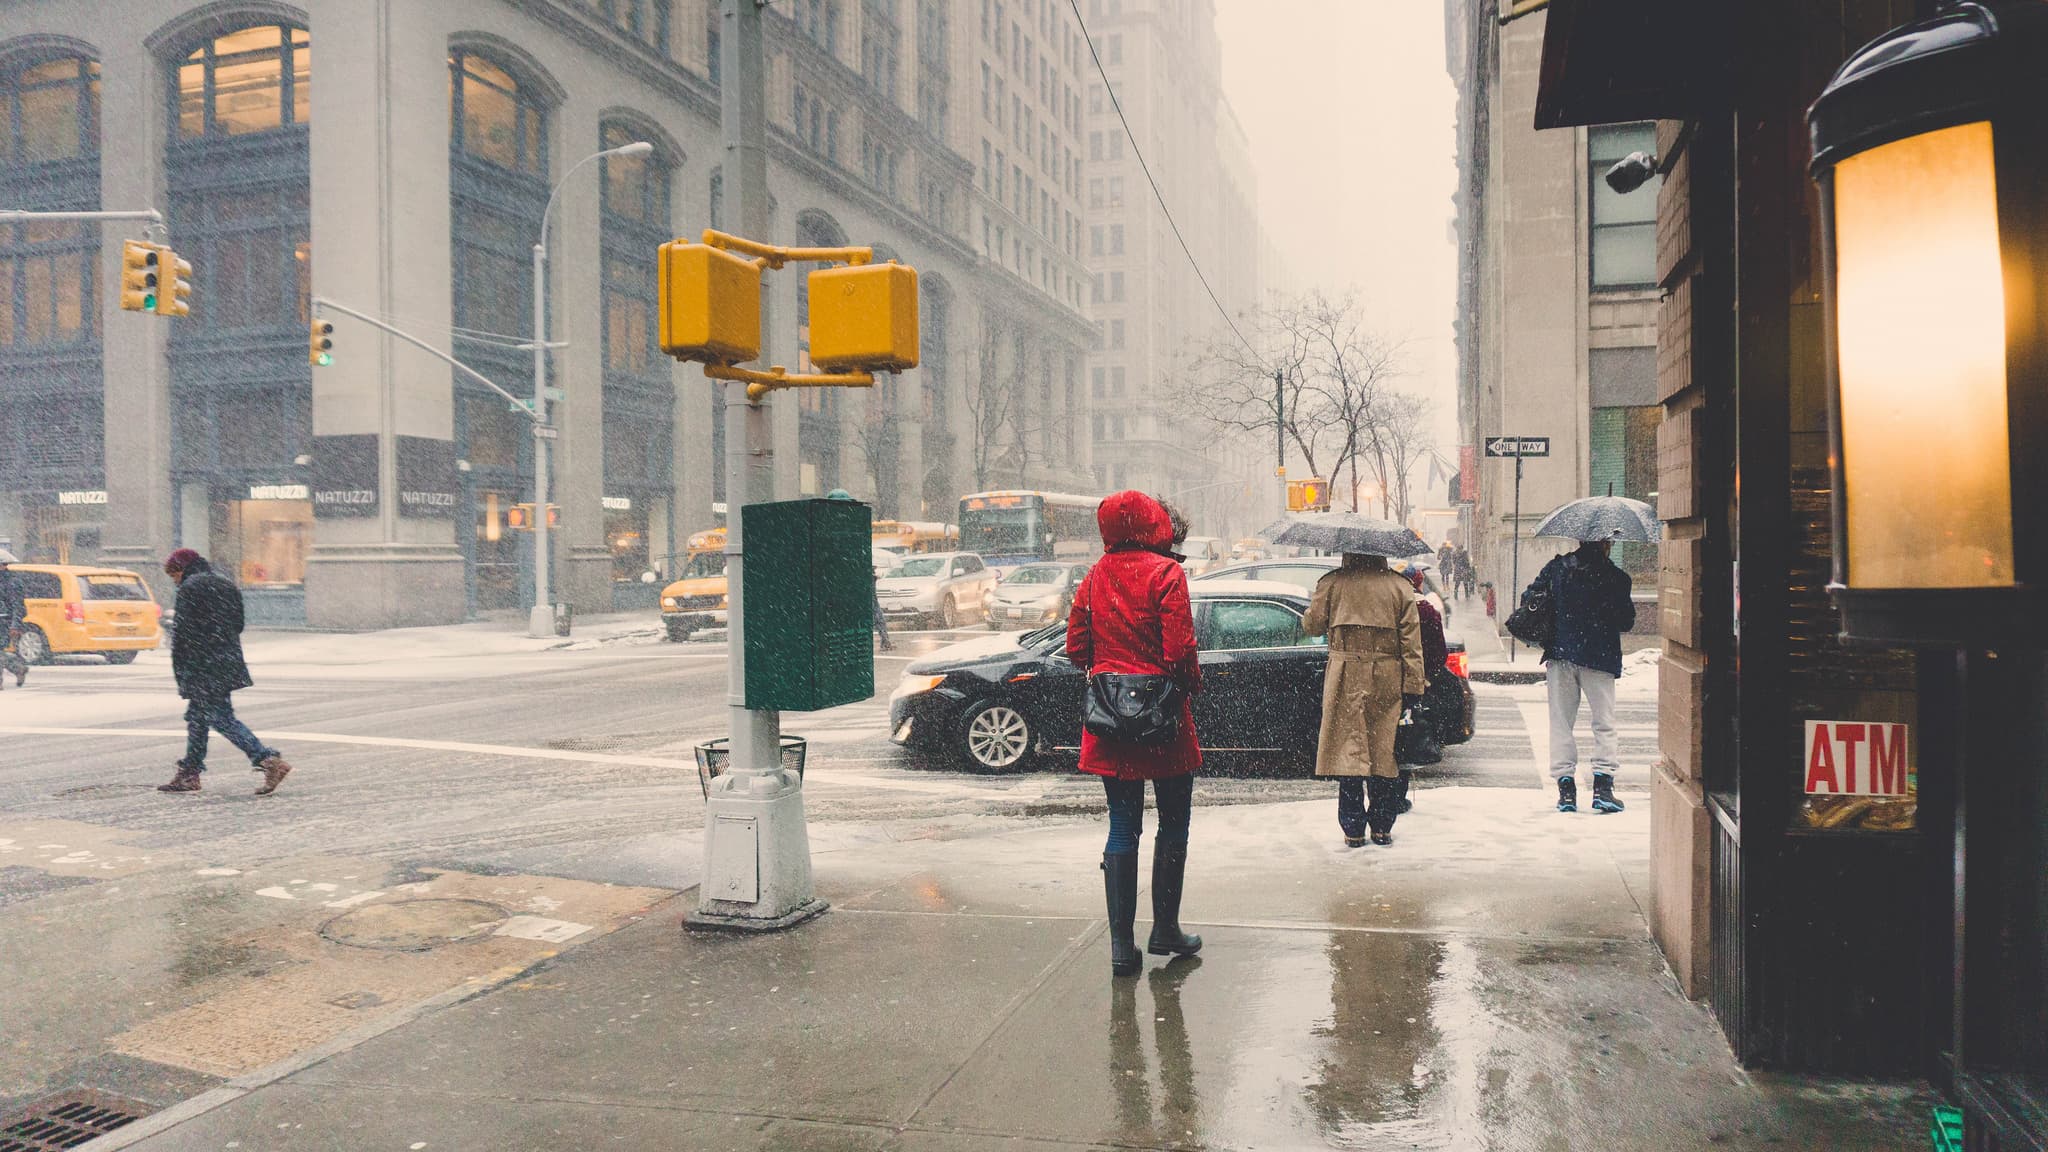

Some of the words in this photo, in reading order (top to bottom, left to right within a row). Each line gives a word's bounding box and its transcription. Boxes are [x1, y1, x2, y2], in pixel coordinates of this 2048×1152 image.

[1495, 443, 1512, 451] ONE
[1521, 443, 1541, 451] WAY
[59, 491, 108, 504] NATUZZI
[250, 485, 309, 499] NATUZZI
[315, 490, 374, 504] NATUZZI
[402, 491, 453, 505] NATUZZI
[1806, 724, 1906, 795] ATM
